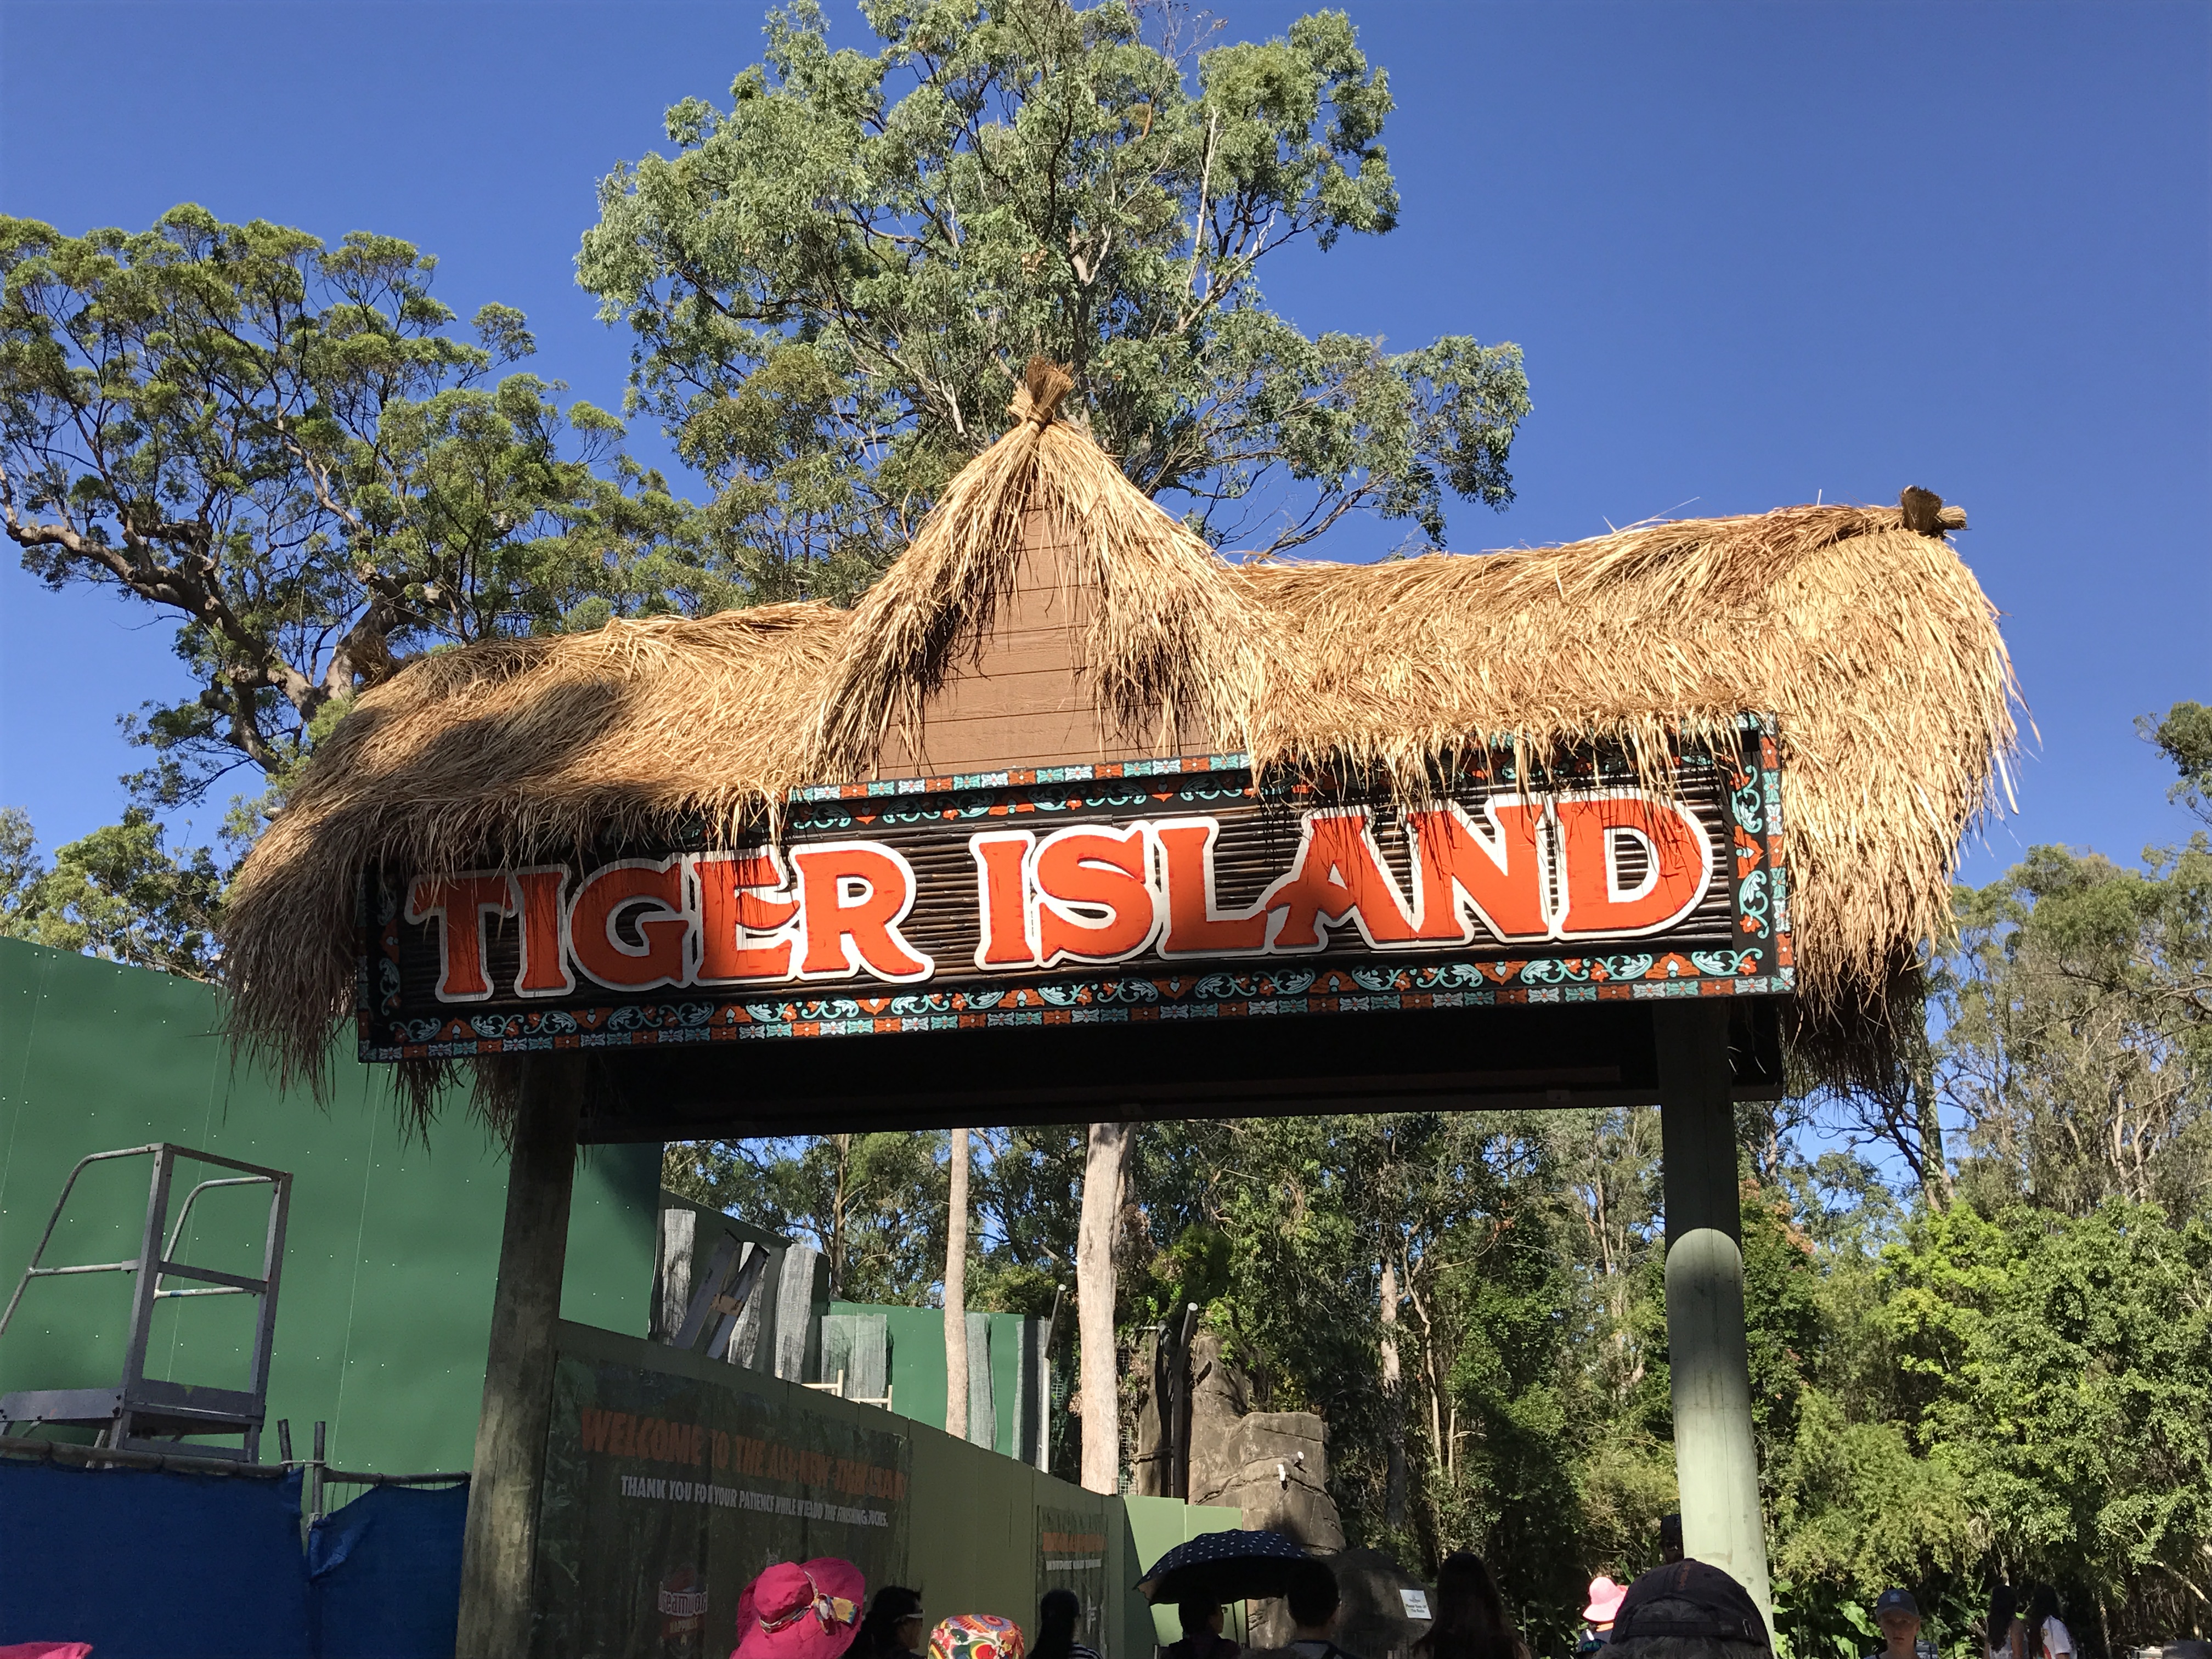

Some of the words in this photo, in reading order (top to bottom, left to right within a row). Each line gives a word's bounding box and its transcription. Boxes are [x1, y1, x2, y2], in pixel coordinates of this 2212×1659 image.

[404, 840, 934, 1003] TIGER
[968, 786, 1713, 970] ISLAND
[582, 1407, 703, 1466] WELCOME
[710, 1429, 730, 1469] TO
[735, 1435, 766, 1477] THE
[621, 1475, 666, 1499] THANK
[669, 1481, 692, 1502] YOU
[713, 1486, 738, 1508] YOUR
[739, 1490, 775, 1514] PATIENCE
[775, 1496, 797, 1515] WHILE
